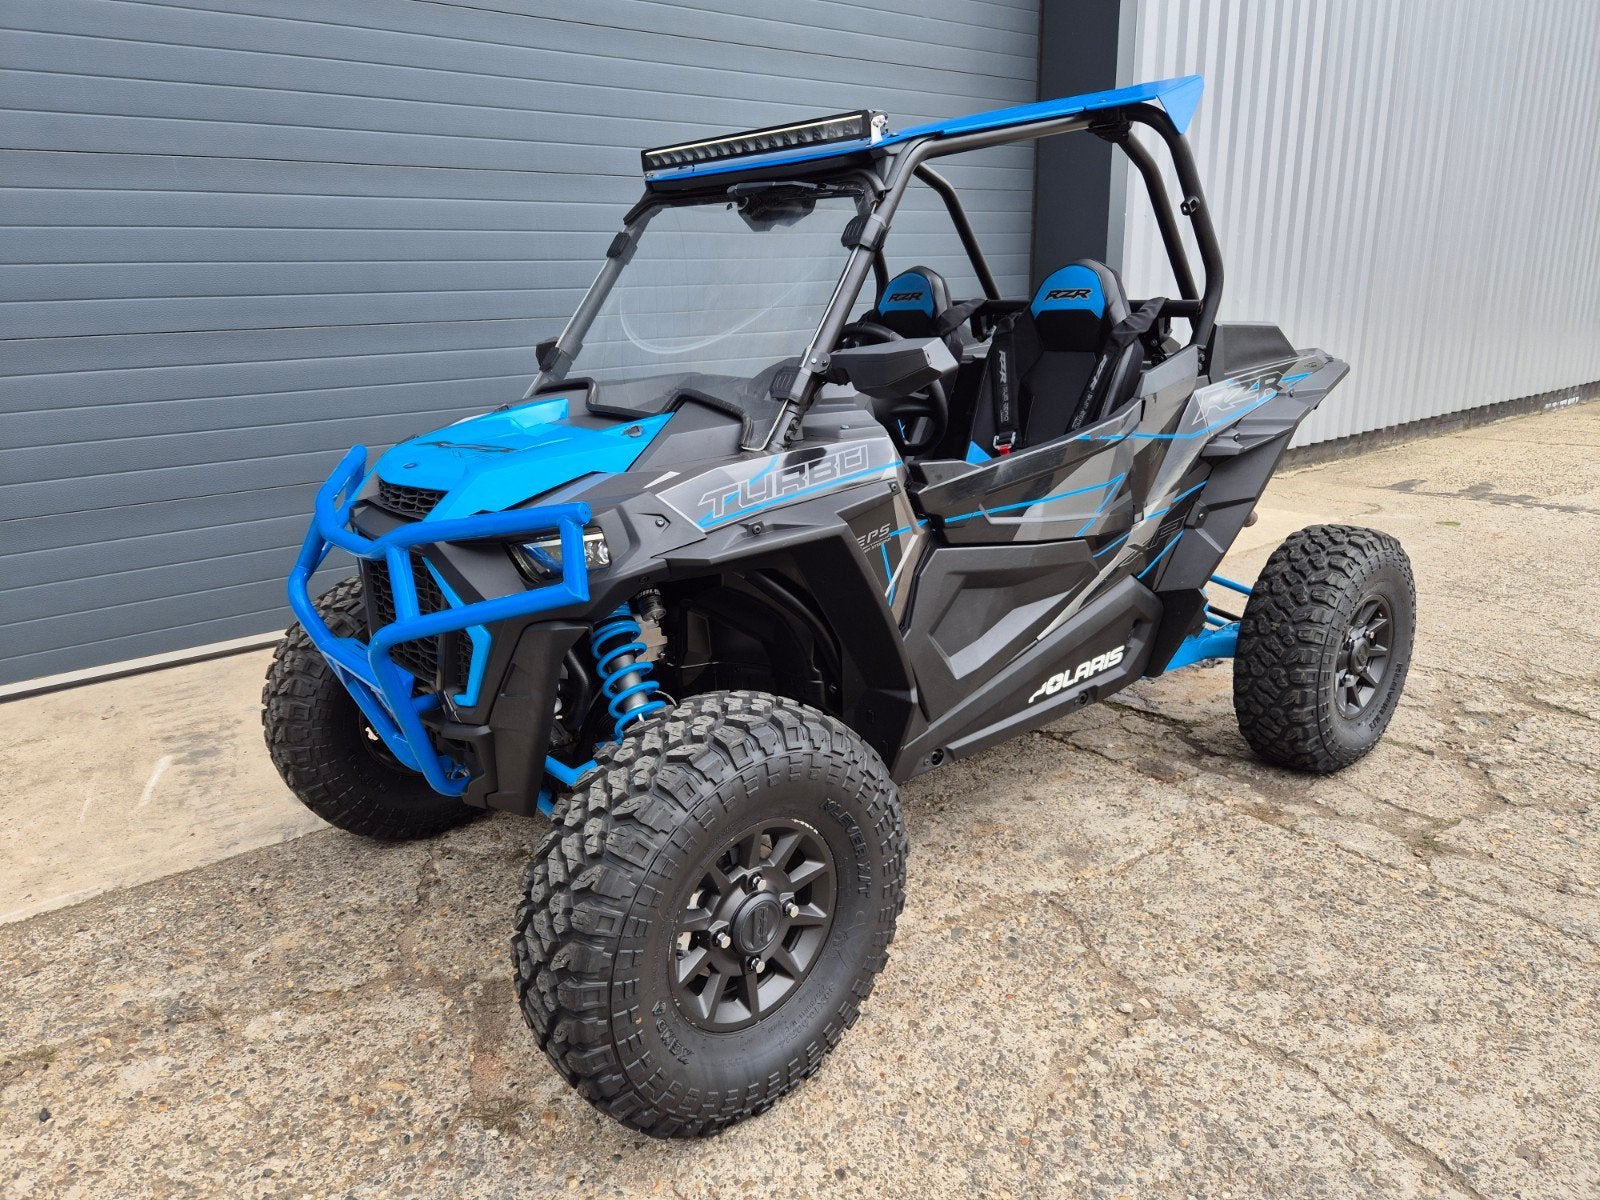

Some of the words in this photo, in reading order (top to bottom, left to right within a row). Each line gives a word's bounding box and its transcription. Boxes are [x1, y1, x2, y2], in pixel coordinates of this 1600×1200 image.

[888, 292, 922, 302] RZR
[1044, 289, 1091, 300] RZR
[999, 350, 1007, 384] RZR
[698, 444, 868, 519] TURBO
[857, 523, 890, 546] EPS
[1028, 645, 1125, 703] POLARIS
[820, 799, 871, 859] KLEVER
